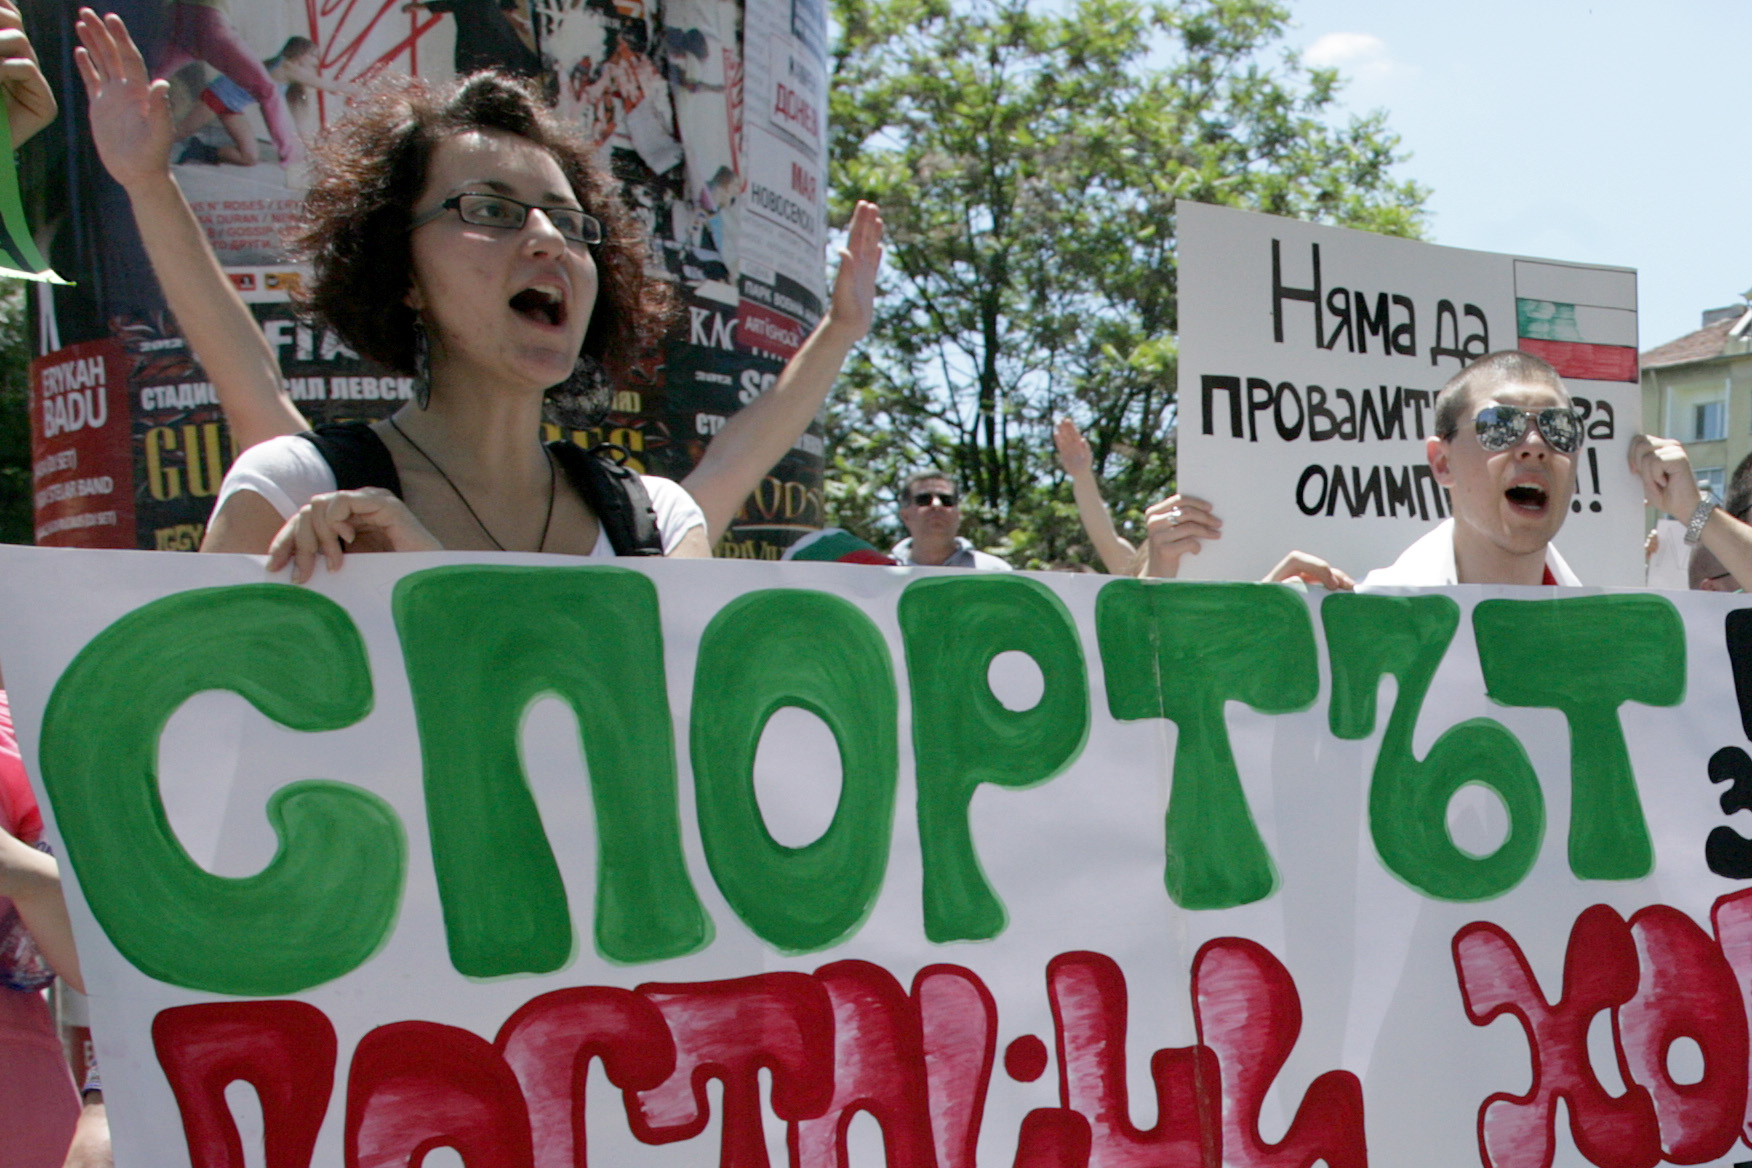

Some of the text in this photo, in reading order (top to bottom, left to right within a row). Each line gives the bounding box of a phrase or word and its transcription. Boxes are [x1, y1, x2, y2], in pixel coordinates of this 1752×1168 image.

[42, 355, 106, 398] ERYKAH
[44, 387, 108, 438] BADU
[38, 564, 1688, 997] СПОРТЪТ
